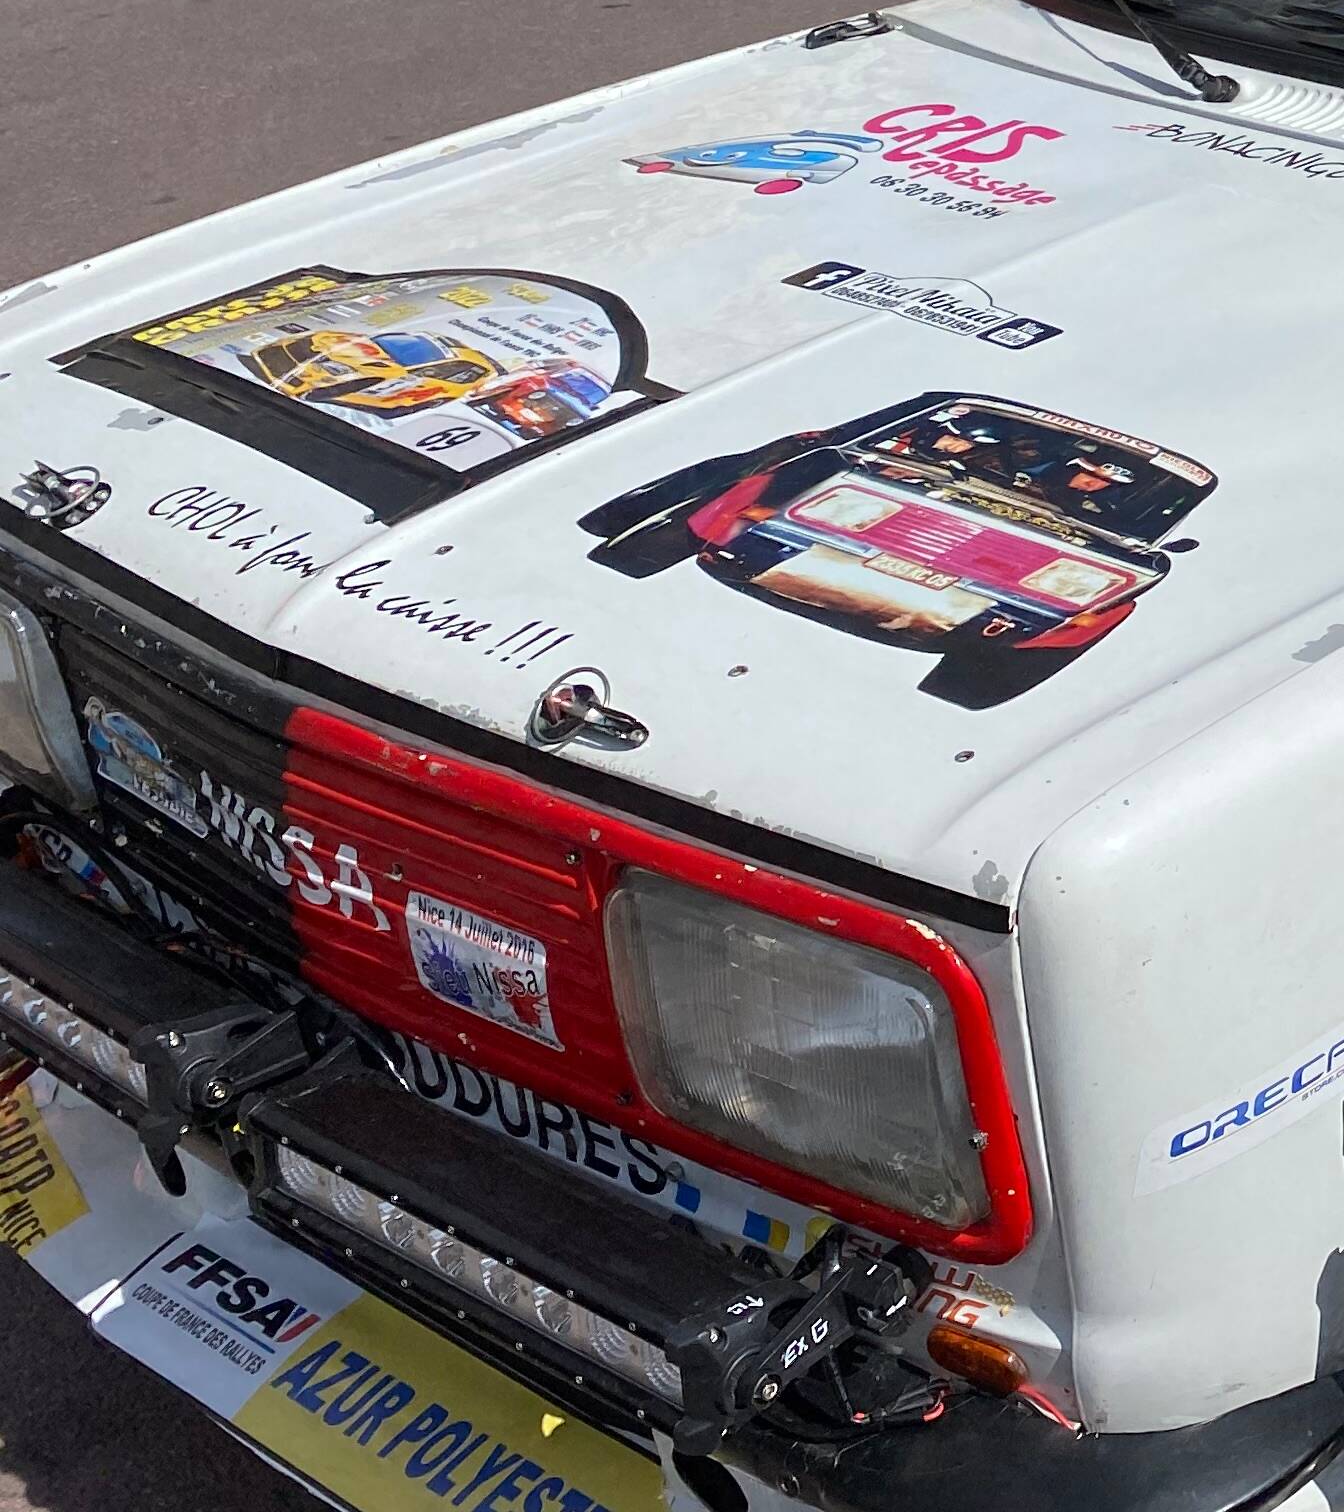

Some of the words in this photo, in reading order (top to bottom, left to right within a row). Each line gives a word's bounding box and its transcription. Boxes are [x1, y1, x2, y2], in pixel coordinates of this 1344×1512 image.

[863, 104, 1067, 164] CRIS
[994, 330, 1027, 345] Tube
[415, 426, 481, 452] 69
[147, 486, 262, 540] CHOL
[417, 894, 445, 929] Nice
[449, 903, 463, 931] 14
[464, 914, 505, 951] Juillet
[504, 934, 537, 965] 2016
[472, 960, 540, 996] Nissa
[400, 1028, 668, 1196] UDURES
[161, 1243, 301, 1340] FFSA
[131, 1282, 169, 1311] COUPE
[158, 1298, 176, 1319] DE
[169, 1304, 211, 1341] FRANCE
[204, 1324, 230, 1351] DES
[218, 1338, 267, 1376] RALLYES
[271, 1339, 417, 1460] AZUR
